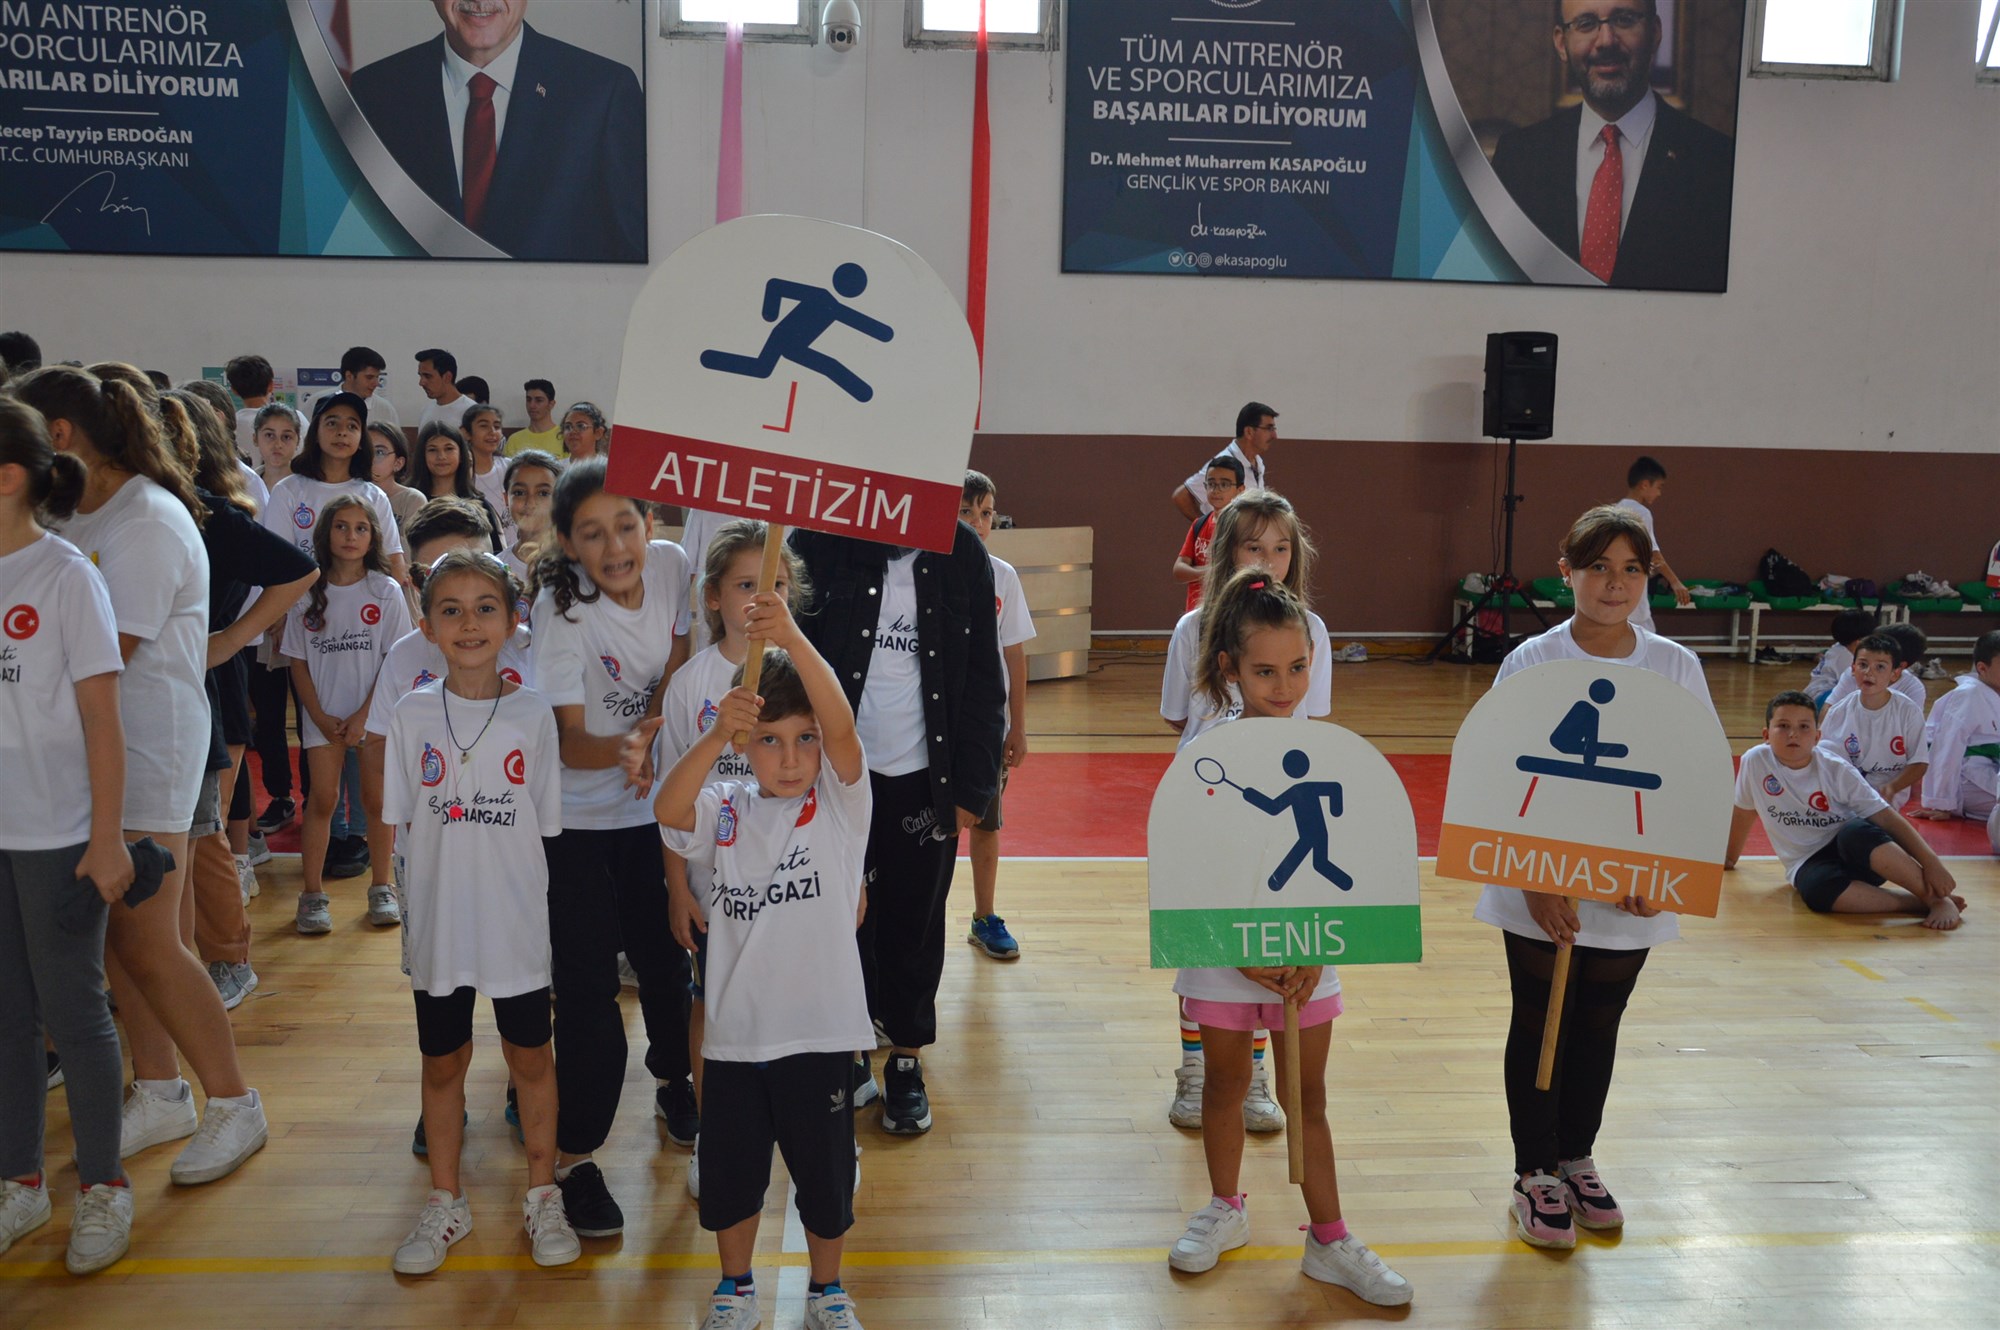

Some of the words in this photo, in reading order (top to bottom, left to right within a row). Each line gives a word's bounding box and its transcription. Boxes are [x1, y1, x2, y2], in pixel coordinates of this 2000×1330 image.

[40, 3, 208, 36] ANTRENÖR
[1120, 34, 1183, 63] TÜM
[1192, 40, 1342, 69] ANTRENÖR
[93, 69, 239, 97] DİLİYORUM
[1088, 66, 1121, 91] VE
[1130, 67, 1373, 100] SPORCULARIMIZA
[1093, 100, 1227, 125] BAŞARILAR
[1234, 101, 1366, 128] DİLİYORUM
[46, 125, 103, 144] Tayyip
[107, 126, 193, 143] ERDOĞAN
[0, 146, 29, 162] T.C.
[33, 148, 189, 170] CUMHURBAŞKANI
[1090, 152, 1113, 166] Dr.
[1117, 152, 1181, 168] Mehmet
[1185, 154, 1266, 171] Muharrem
[1269, 157, 1367, 174] KASAPOĞLU
[1126, 173, 1196, 194] GENÇLİK
[1200, 176, 1219, 191] VE
[1223, 178, 1266, 193] SPOR
[1270, 180, 1330, 195] BAKANI
[1214, 254, 1287, 269] @kasapoglu
[650, 452, 912, 535] ATLETİZİM
[321, 639, 372, 654] ORHANGAZİ
[1783, 815, 1846, 828] ORHANGAZ
[1468, 837, 1688, 905] CİMNASTİK
[1232, 912, 1346, 958] TENİS
